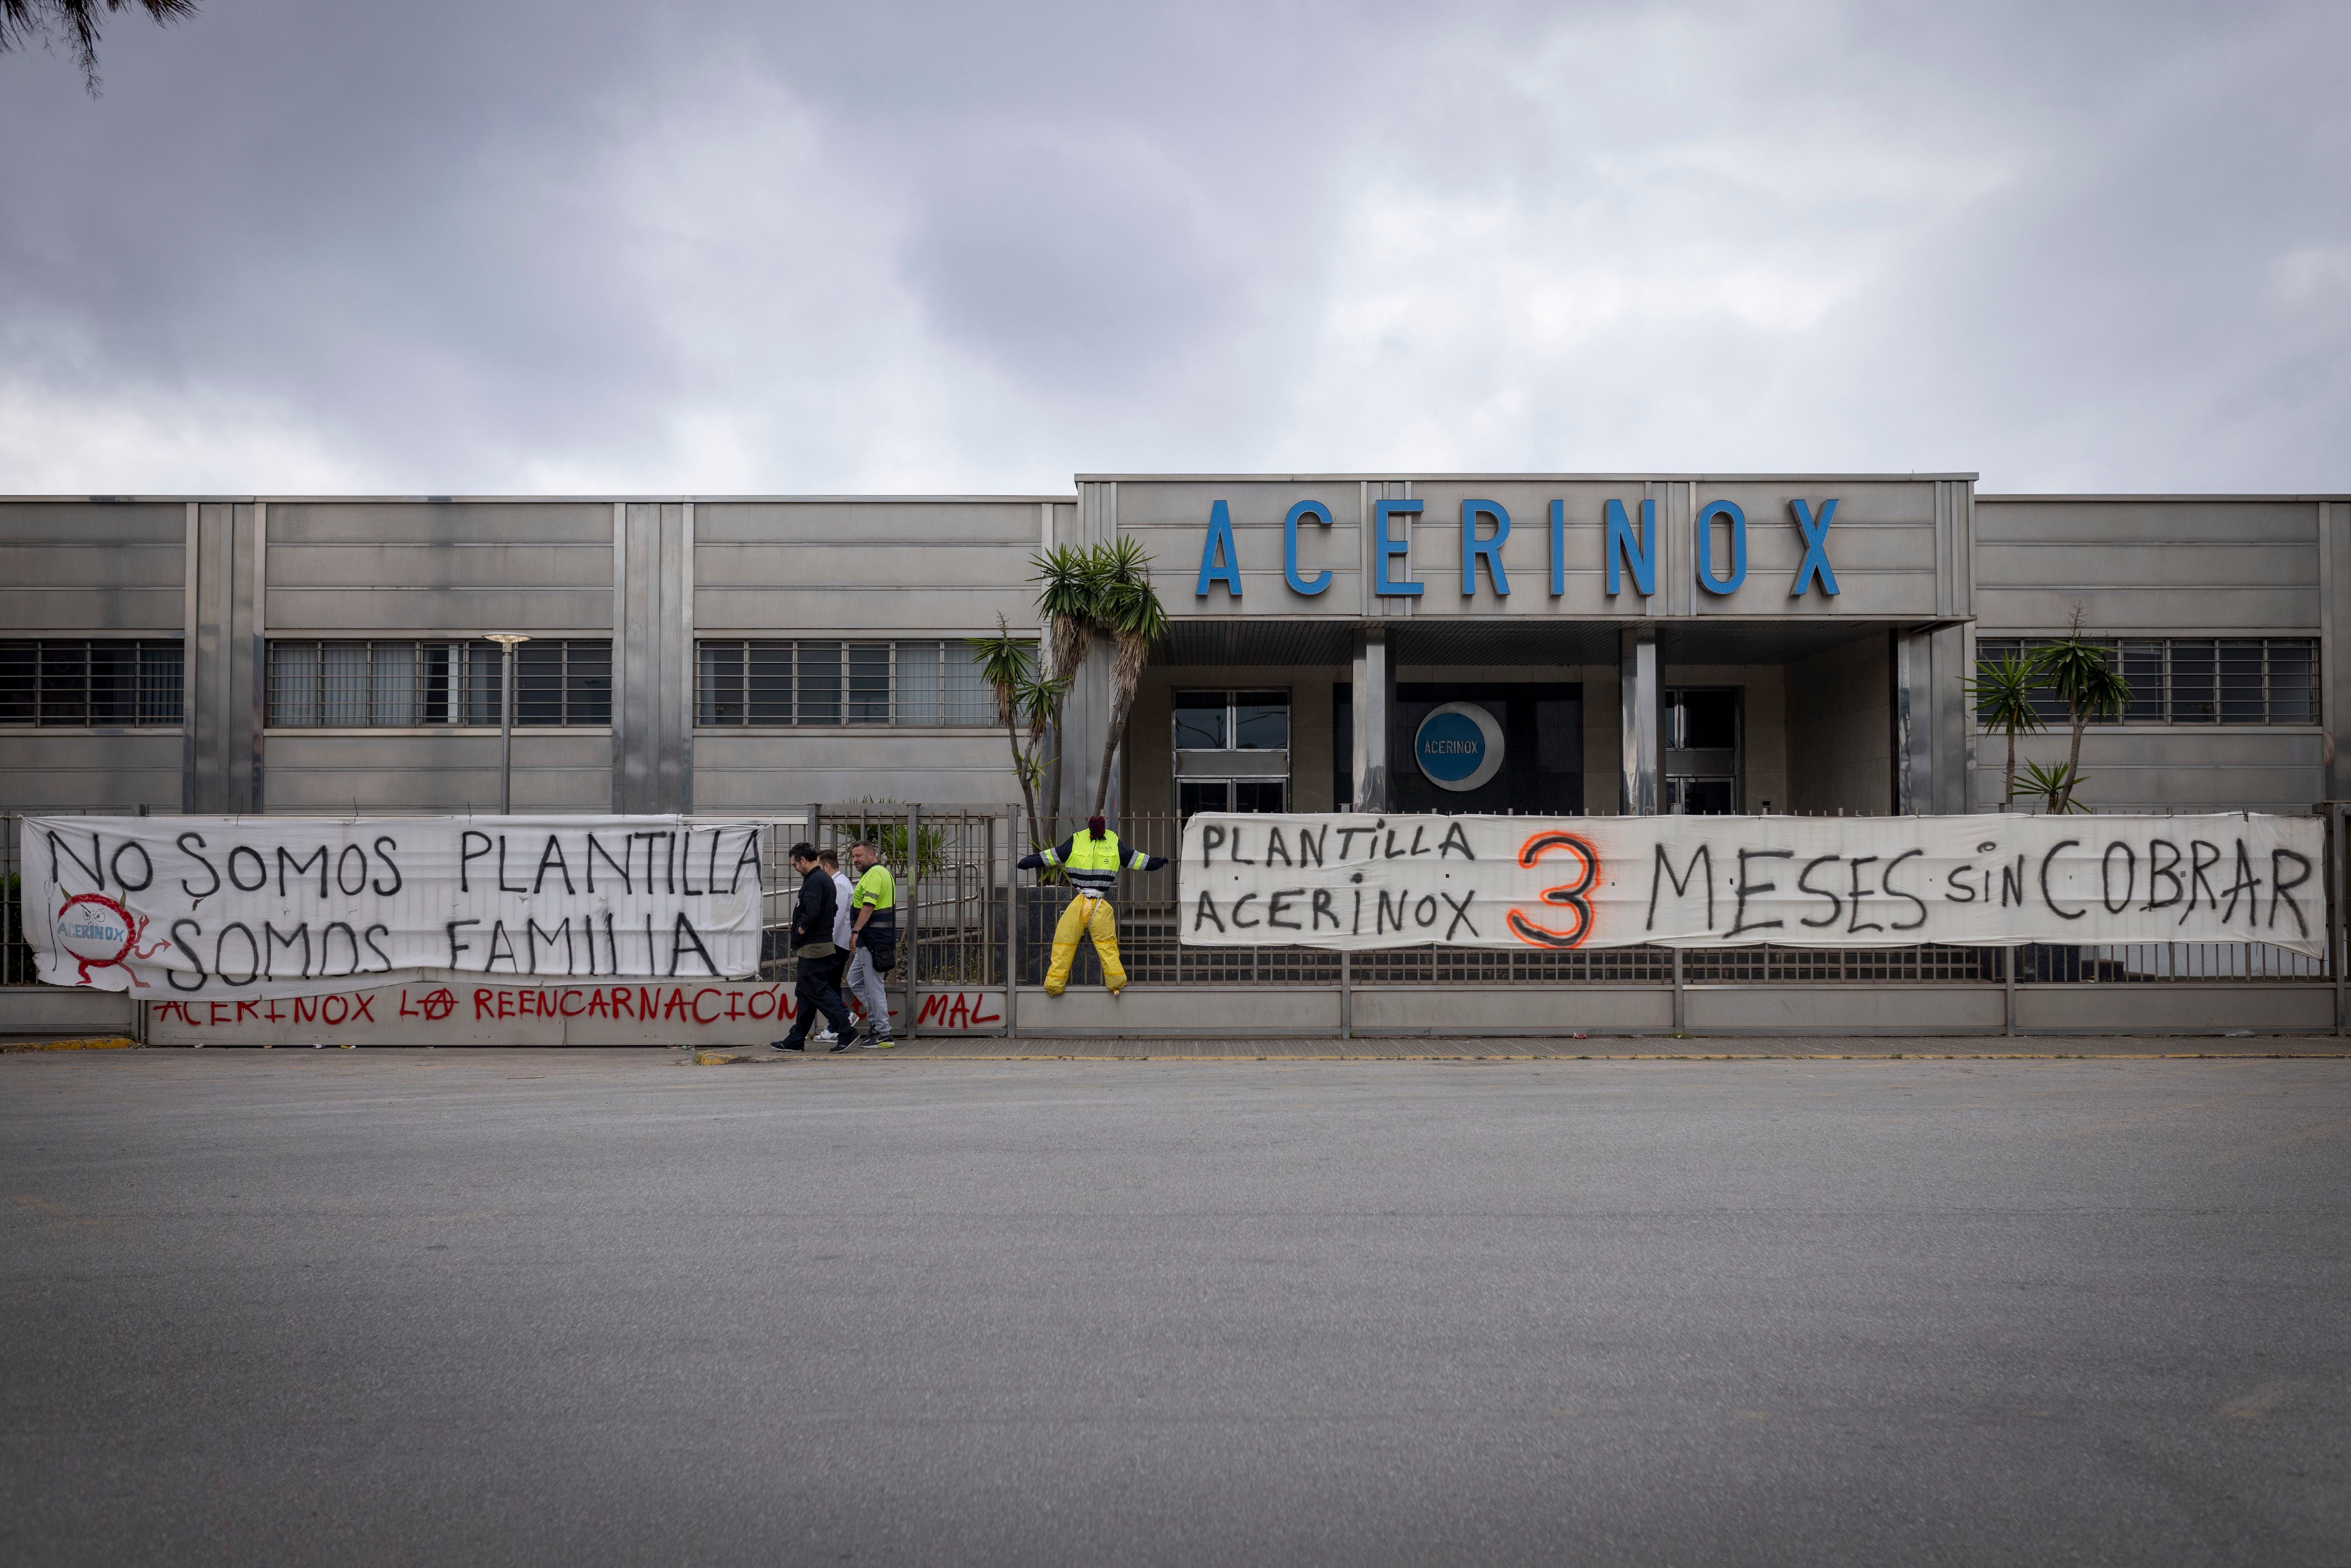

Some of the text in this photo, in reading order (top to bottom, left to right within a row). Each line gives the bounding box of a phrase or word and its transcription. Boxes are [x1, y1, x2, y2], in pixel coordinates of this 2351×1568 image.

[1196, 499, 1840, 596] ACERINOX
[1424, 740, 1478, 754] ACERINOX
[46, 829, 763, 899] NO SOMOS PLANTILLA
[1506, 830, 1602, 949] 3
[1645, 841, 1927, 939] MESES
[2039, 838, 2312, 939] COBRAR
[57, 922, 125, 942] ACERINOX
[167, 919, 392, 992] SOMOS
[153, 993, 375, 1027] ACERINOX
[917, 992, 1000, 1029] MAL
